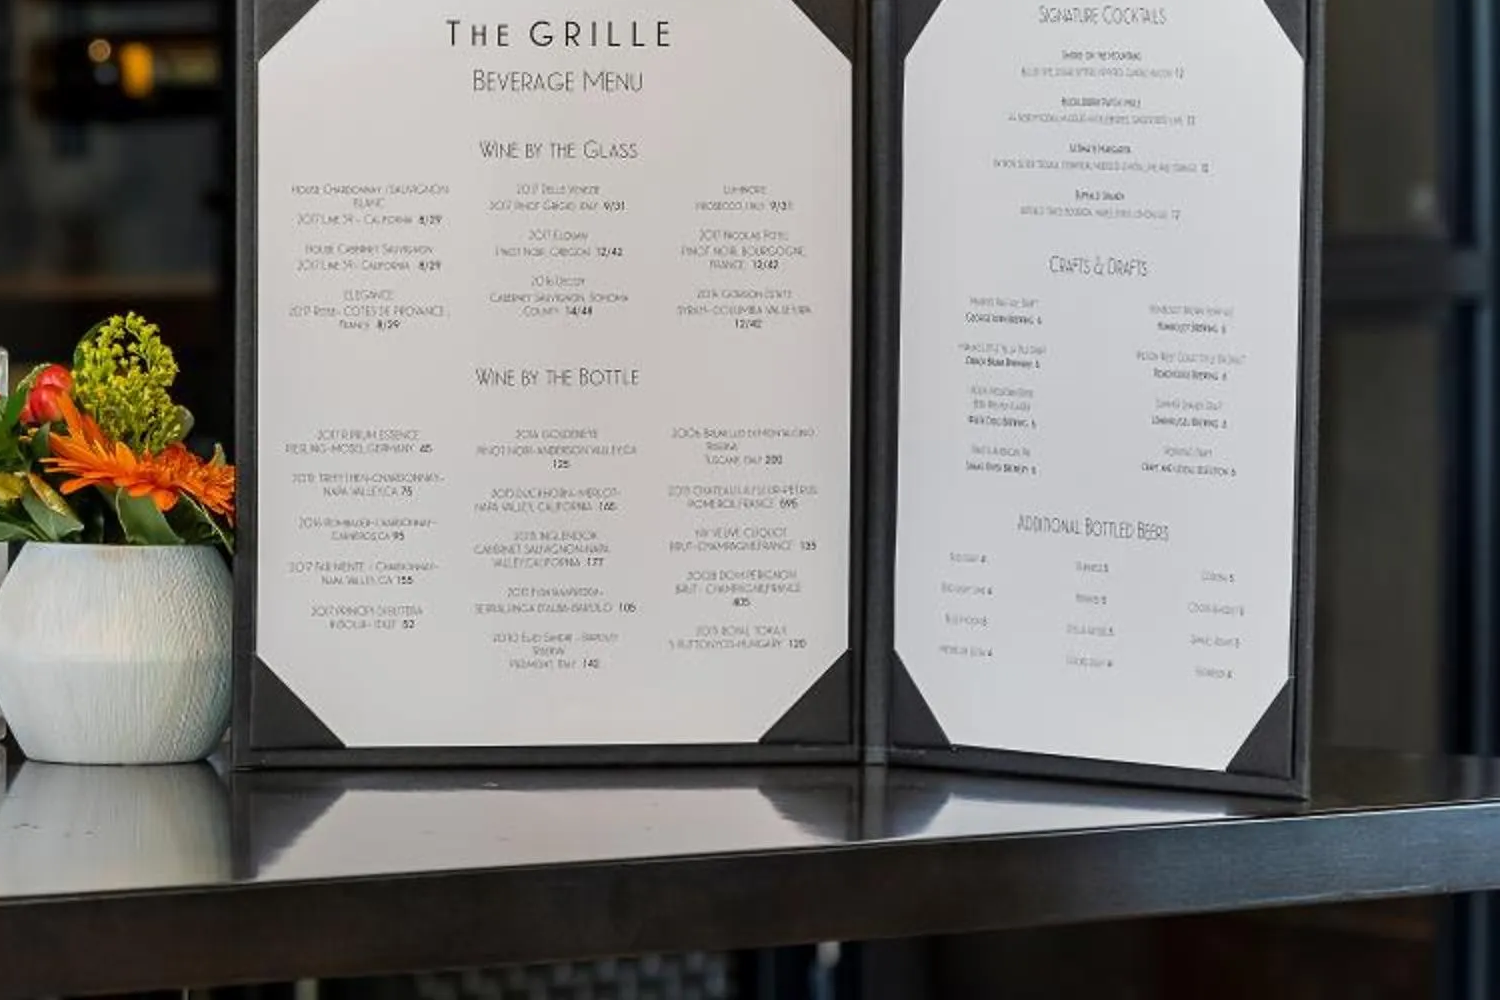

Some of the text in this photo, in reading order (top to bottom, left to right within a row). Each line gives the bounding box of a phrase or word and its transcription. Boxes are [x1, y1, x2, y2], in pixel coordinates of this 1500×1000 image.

[446, 19, 670, 47] THE GRILLE
[472, 69, 644, 92] BEVERAGE MENU
[479, 139, 519, 159] WINE
[583, 139, 638, 159] GLASS
[475, 367, 515, 388] WINE
[579, 367, 640, 388] BOTTLE
[1085, 517, 1133, 540] BOTTLED
